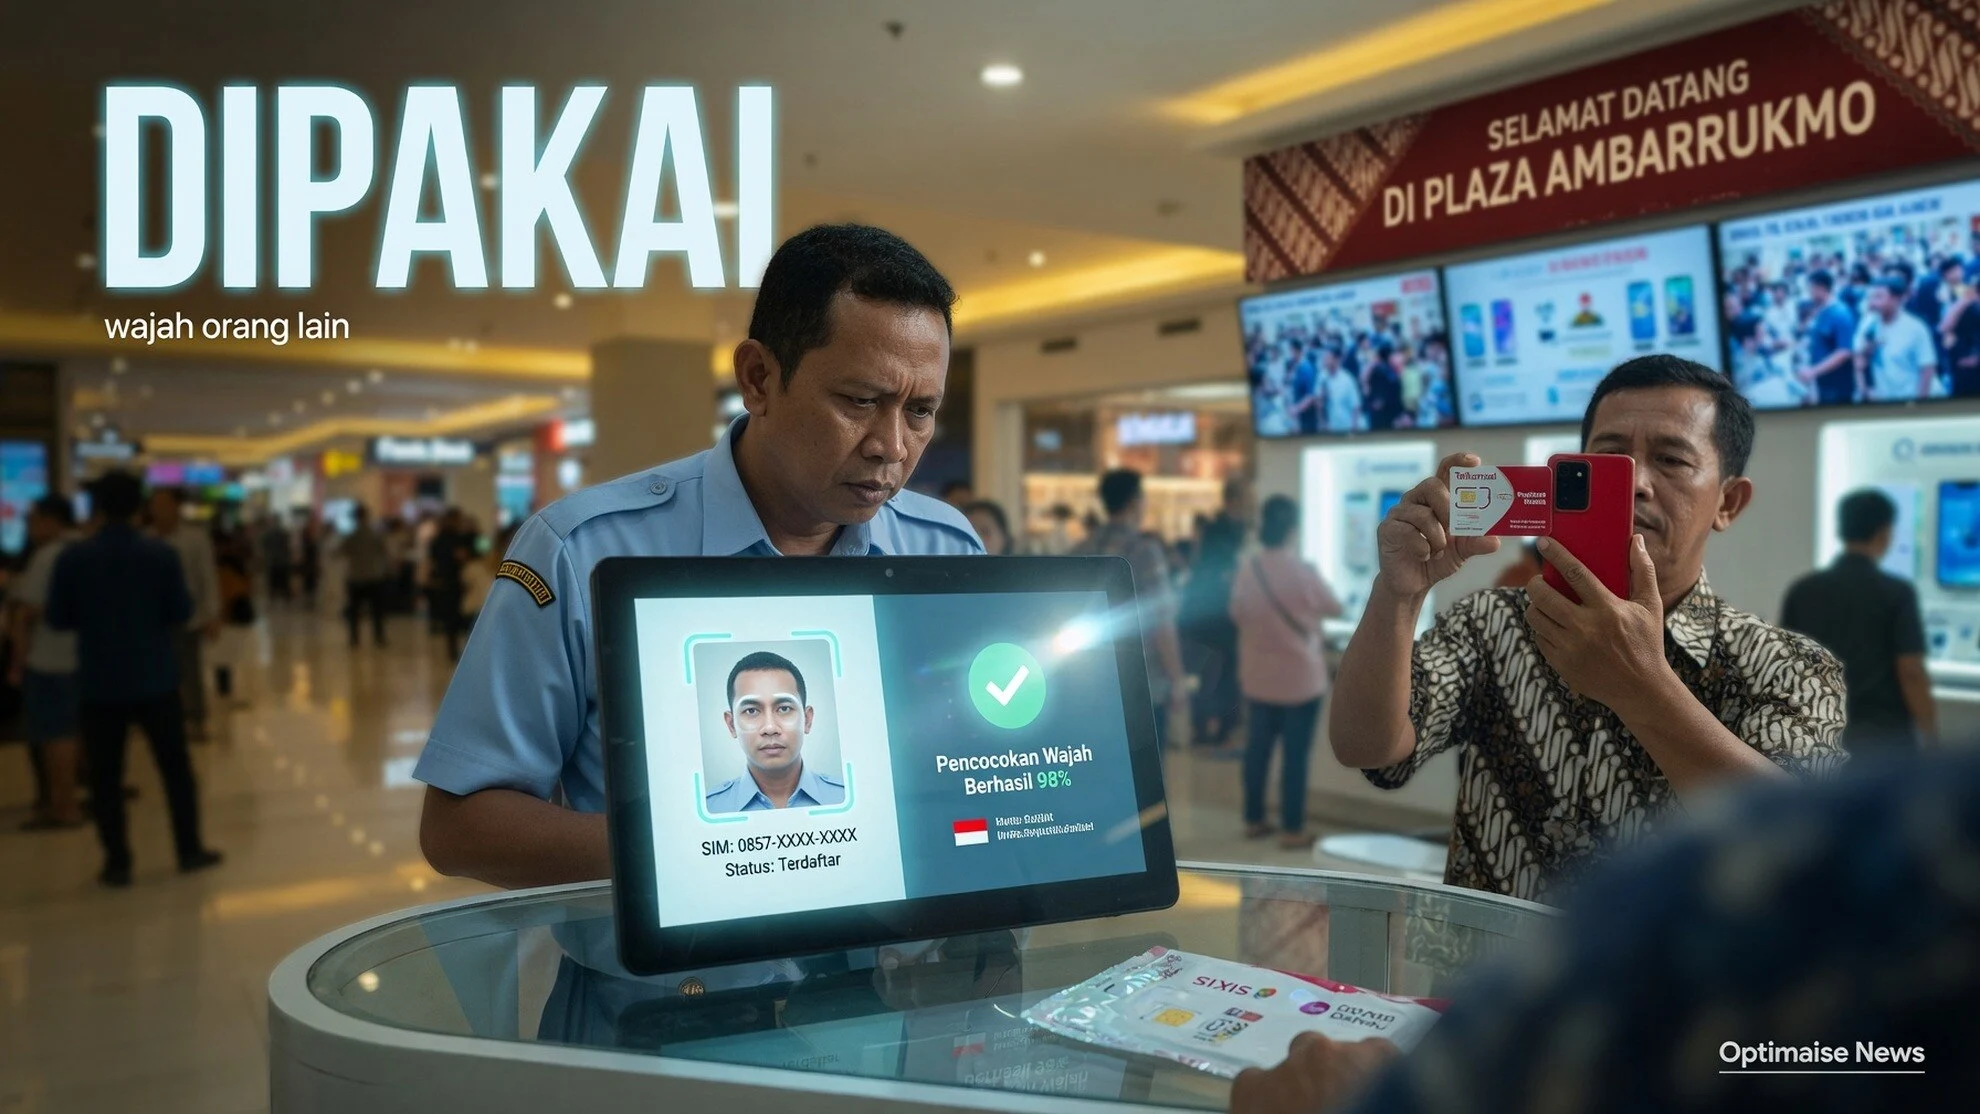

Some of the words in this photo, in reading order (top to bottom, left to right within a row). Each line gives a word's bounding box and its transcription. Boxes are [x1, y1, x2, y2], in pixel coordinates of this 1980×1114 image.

[1487, 91, 1616, 151] SELAMAT
[1622, 58, 1750, 120] DATANG
[1383, 182, 1416, 228] DI
[1424, 155, 1536, 220] PLAZA
[1545, 80, 1876, 198] AMBARRUKMO
[936, 750, 1039, 773] Pencocokan
[1042, 744, 1093, 767] Wajah
[964, 773, 1033, 795] Berhasil
[1036, 770, 1072, 789] 98%
[701, 838, 734, 857] SIM:
[737, 827, 858, 853] 0857-XXXX-XXXX
[725, 858, 775, 878] Status:
[778, 852, 841, 872] Terdaftar
[1192, 975, 1252, 996] SIXIS
